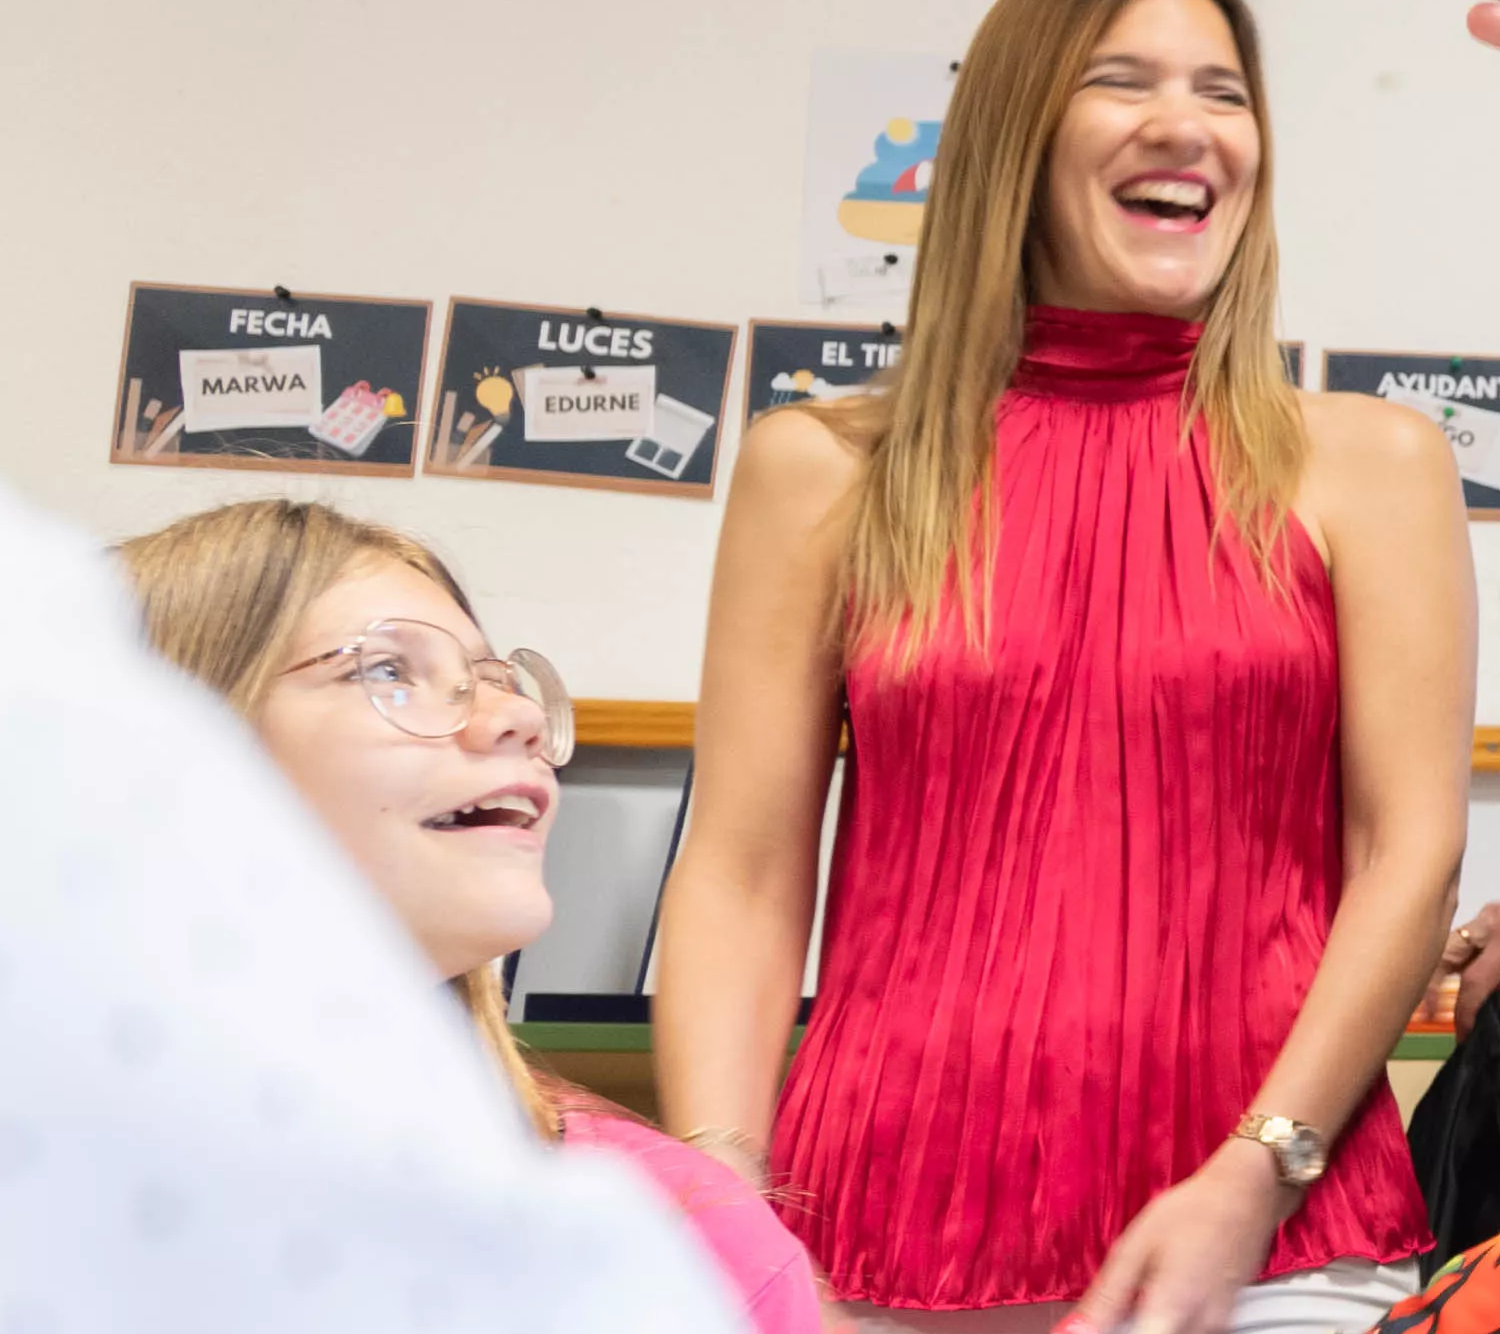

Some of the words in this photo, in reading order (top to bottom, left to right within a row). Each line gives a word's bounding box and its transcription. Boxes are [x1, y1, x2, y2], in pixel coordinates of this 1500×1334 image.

[229, 308, 332, 339] FECHA
[538, 320, 653, 359] LUCES
[821, 341, 853, 367] EL
[201, 373, 306, 396] MARWA
[545, 393, 640, 414] EDURNE
